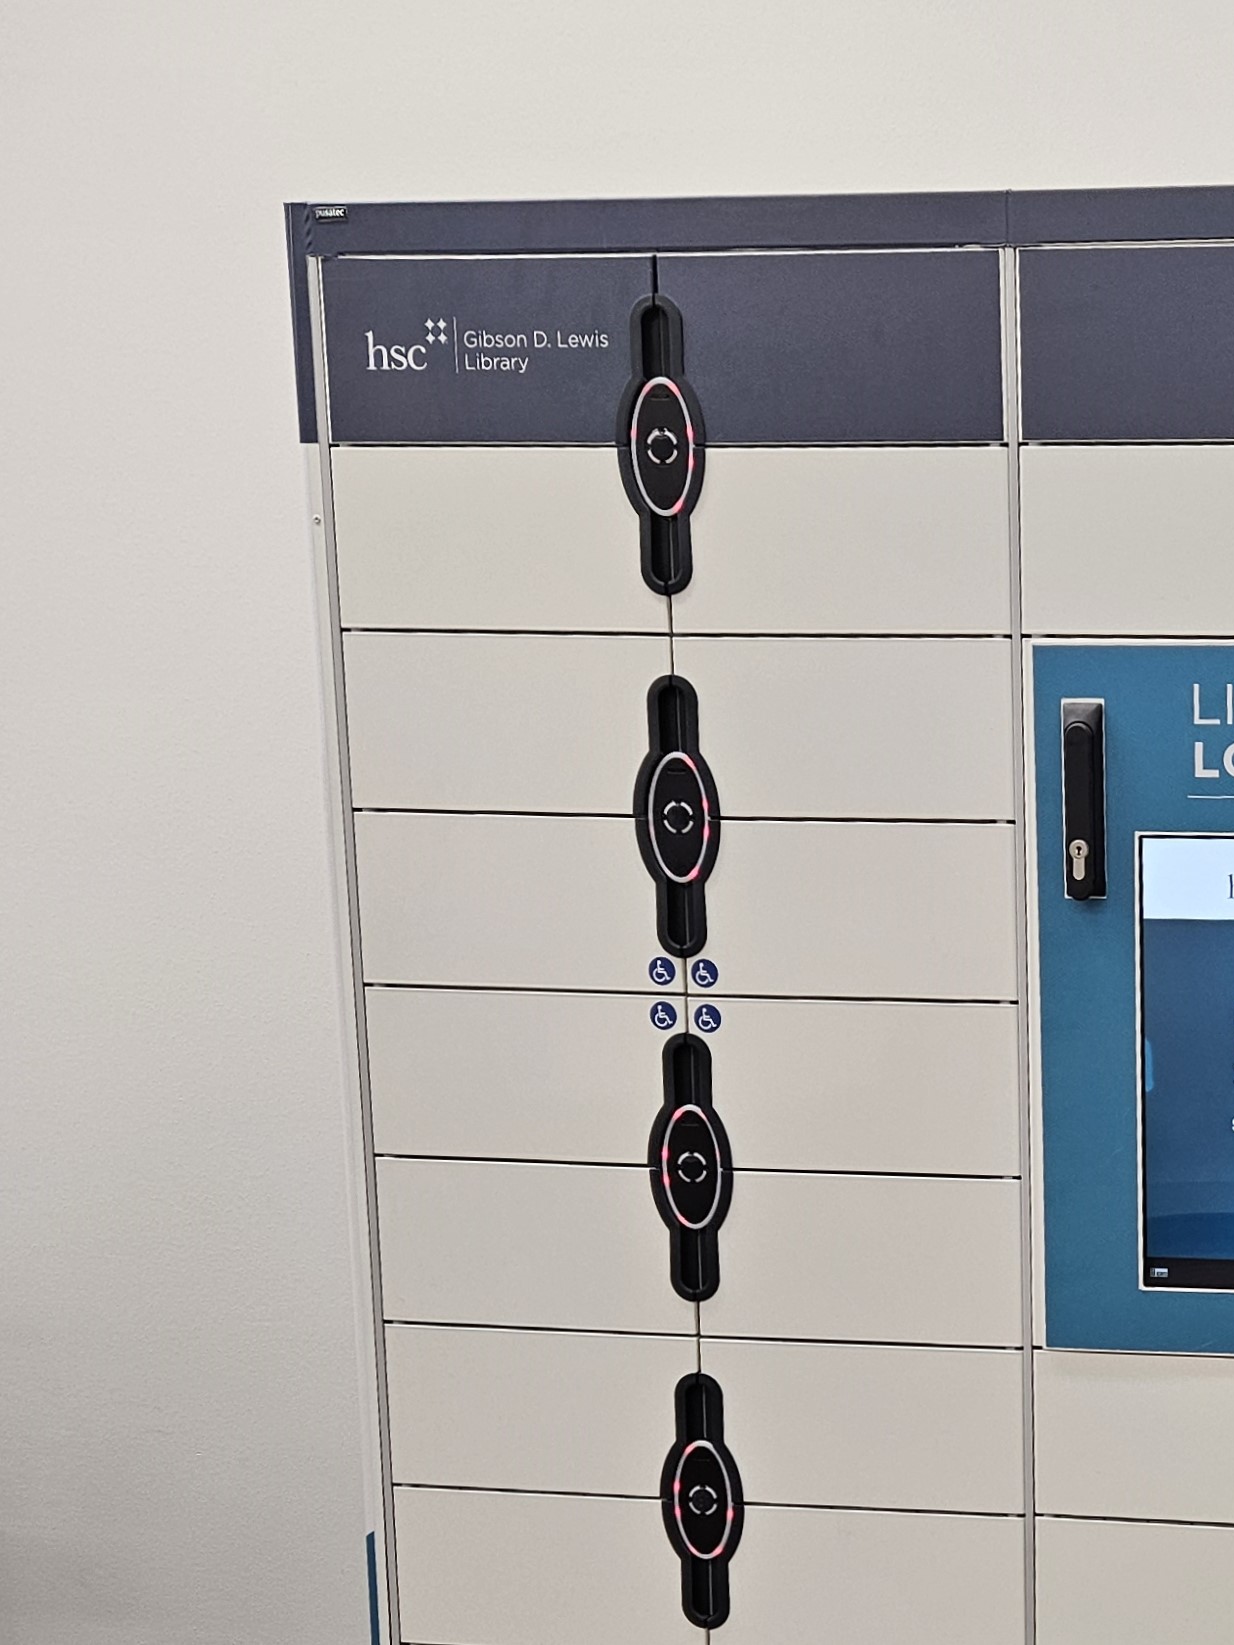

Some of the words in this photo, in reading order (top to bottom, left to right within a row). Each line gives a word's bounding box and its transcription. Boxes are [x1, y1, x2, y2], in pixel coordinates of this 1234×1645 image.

[364, 330, 428, 370] hsc
[463, 330, 527, 349] Gibson
[533, 330, 551, 348] D.
[557, 330, 609, 348] Lewis
[465, 353, 529, 374] Library
